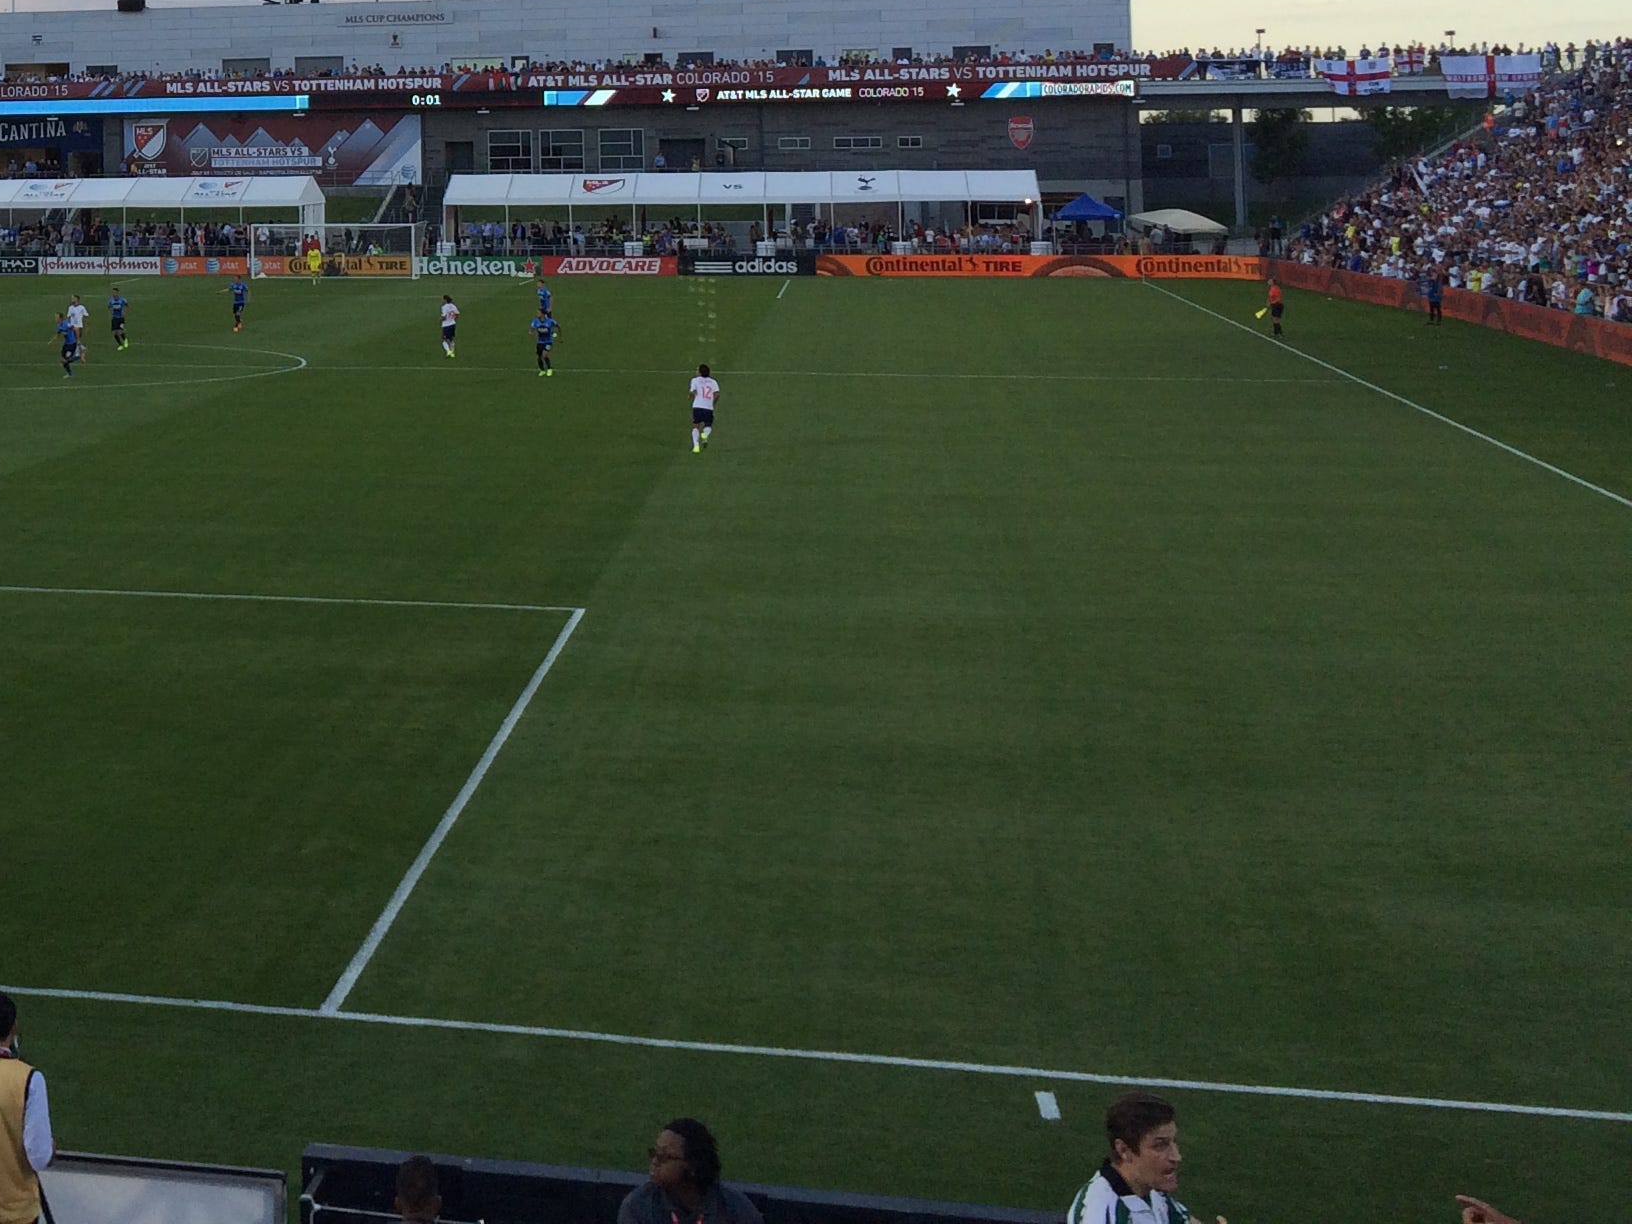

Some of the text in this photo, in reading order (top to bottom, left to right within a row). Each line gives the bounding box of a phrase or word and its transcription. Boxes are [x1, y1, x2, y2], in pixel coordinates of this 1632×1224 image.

[345, 13, 445, 24] MLS CUP CHAMPIONS
[528, 75, 564, 87] AT&T
[568, 75, 598, 87] MLS
[602, 74, 673, 86] ALL-STAR
[676, 72, 750, 84] COLORADO
[828, 64, 1151, 81] MLS ALL-STARS VS TOTTENHAM HOTSPUR
[166, 77, 442, 94] MLS ALL-STARS VS TOTTENHAM HOTSPUR
[1043, 82, 1132, 94] COLORADORAPIDS.COM
[412, 94, 441, 105] 0:01
[717, 90, 743, 100] AT&T
[745, 89, 767, 99] MLS
[769, 88, 819, 99] ALL-STAR
[822, 88, 851, 98] GAME
[858, 87, 909, 98] COLORADO
[136, 127, 153, 135] MLS
[212, 147, 303, 157] MLS ALL-STARS VS
[378, 260, 407, 270] TIRE
[415, 256, 516, 275] Heineken
[557, 258, 661, 274] ADVOCARE
[734, 257, 798, 274] adidas
[865, 256, 1022, 273] Continental TIRE
[1135, 256, 1232, 276] Continental
